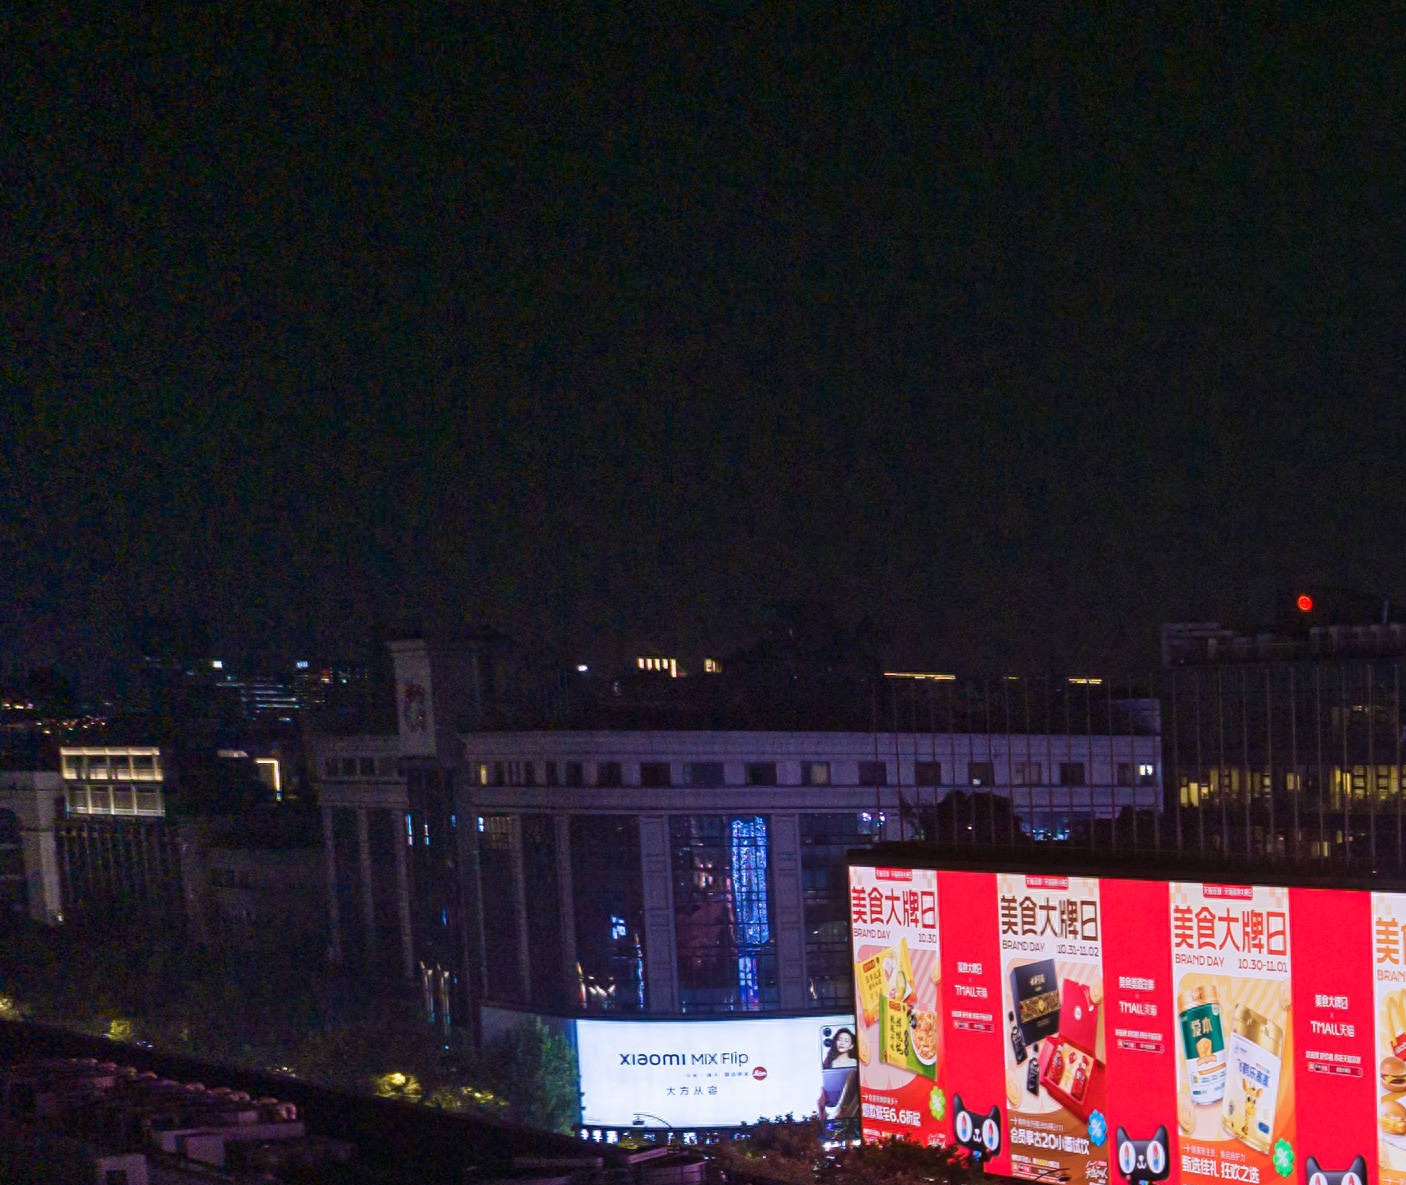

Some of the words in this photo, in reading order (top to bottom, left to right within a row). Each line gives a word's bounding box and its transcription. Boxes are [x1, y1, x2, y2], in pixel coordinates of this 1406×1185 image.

[852, 886, 936, 929] 美食大牌日
[1000, 895, 1098, 942] 美食大牌日
[1173, 905, 1287, 956] 美食大牌日
[1175, 954, 1205, 967] BRAND
[1207, 955, 1224, 968] DAY
[1238, 959, 1288, 973] 10.30-11.01
[620, 1054, 686, 1066] xiaomi
[691, 1054, 718, 1065] MIX
[722, 1052, 749, 1067] Flip
